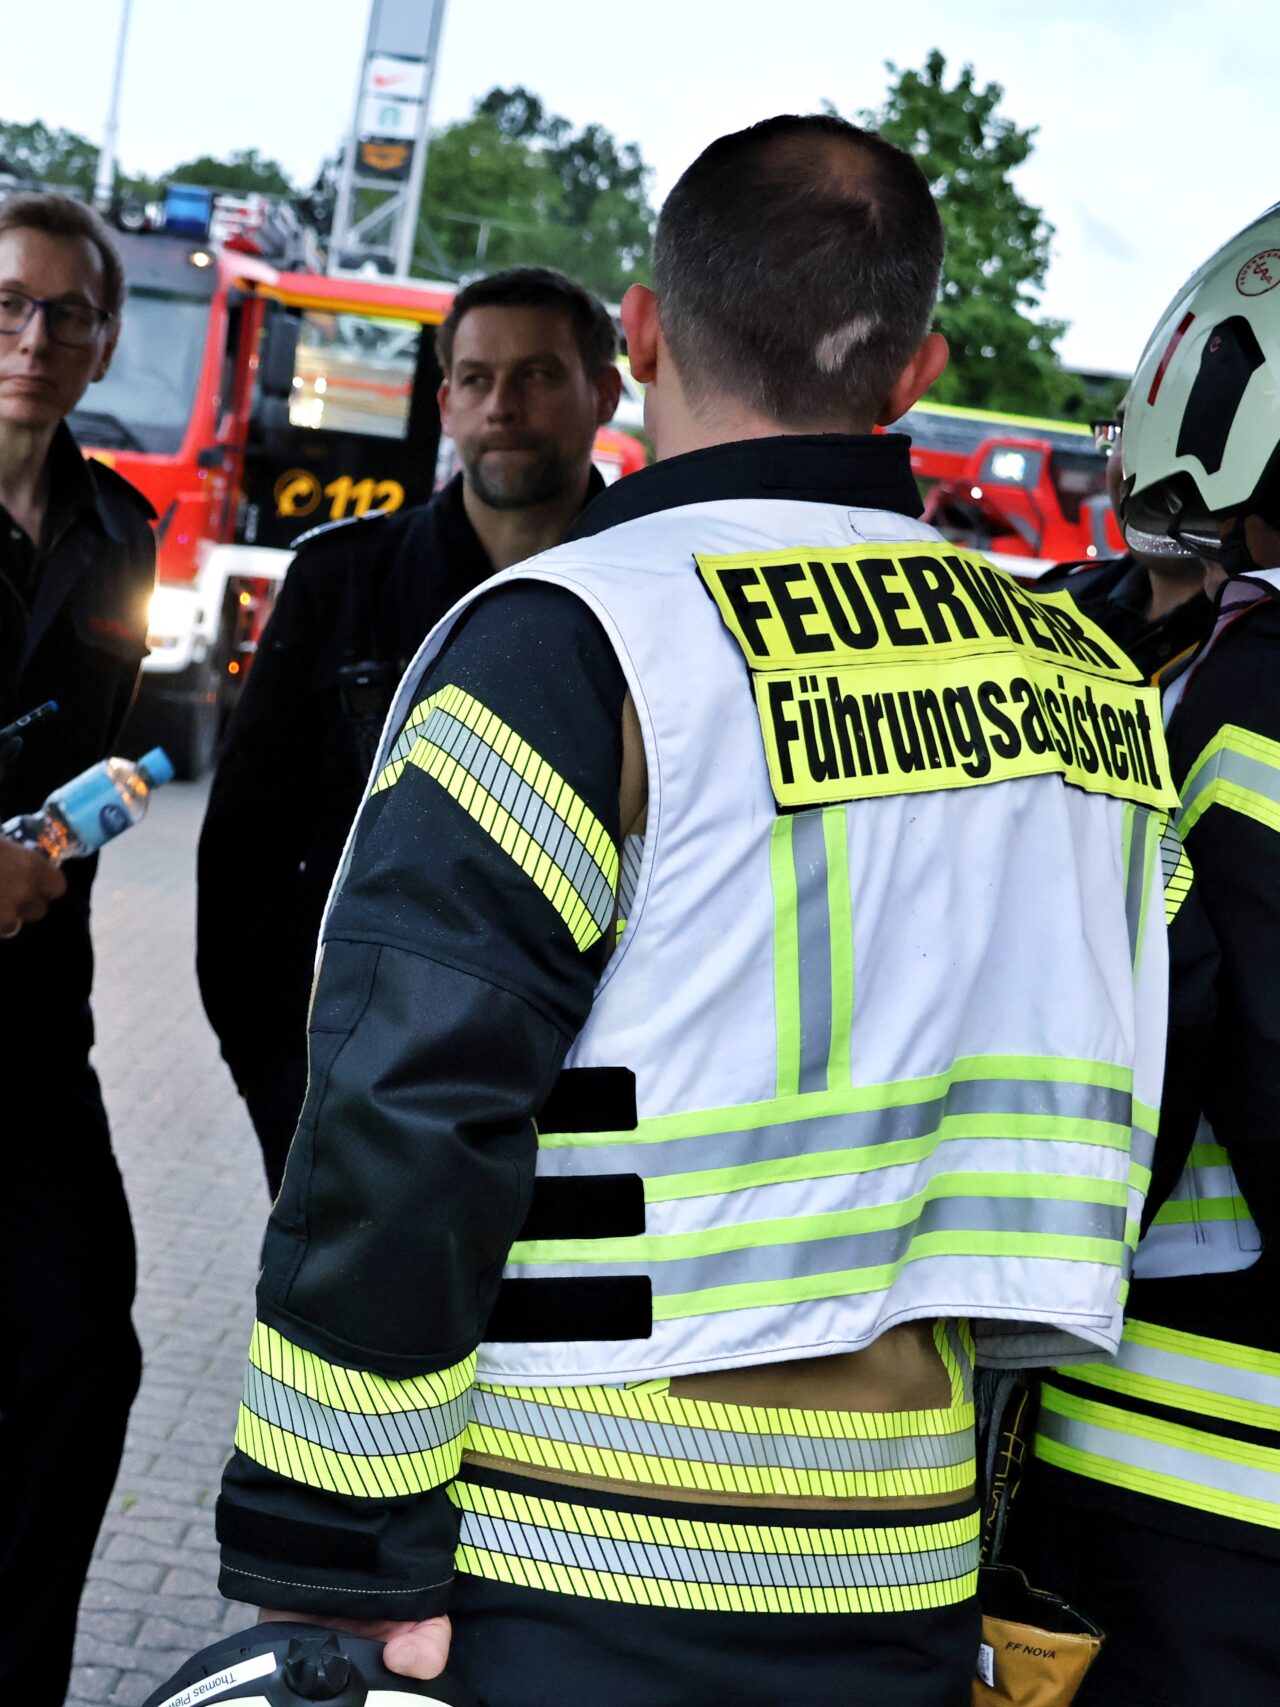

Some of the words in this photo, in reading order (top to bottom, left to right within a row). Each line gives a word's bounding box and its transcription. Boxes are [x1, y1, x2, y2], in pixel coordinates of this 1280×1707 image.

[324, 475, 405, 521] 112
[716, 555, 1122, 670] FEUERWEHR
[767, 673, 1163, 791] Führungsasistent
[1005, 1641, 1023, 1651] FF
[1023, 1645, 1057, 1659] NOVA
[166, 1692, 191, 1707] Plew
[193, 1672, 237, 1698] Thomas
